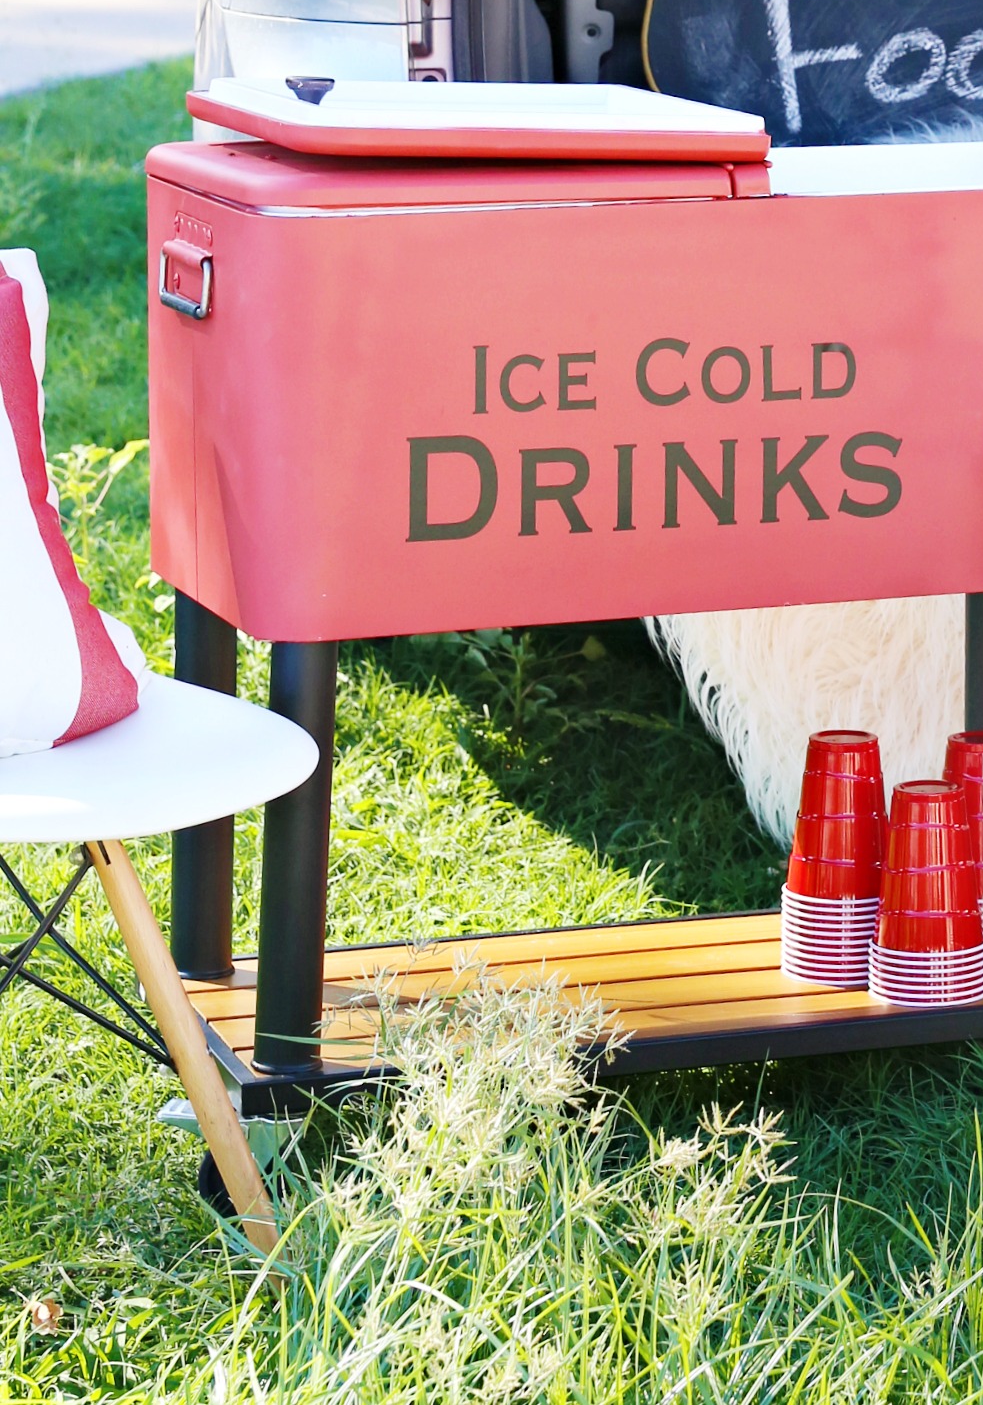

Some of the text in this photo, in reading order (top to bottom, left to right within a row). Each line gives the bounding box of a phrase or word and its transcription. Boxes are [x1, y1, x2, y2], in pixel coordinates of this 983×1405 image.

[474, 338, 856, 415] ICE COLD
[406, 432, 903, 542] DRINKS
